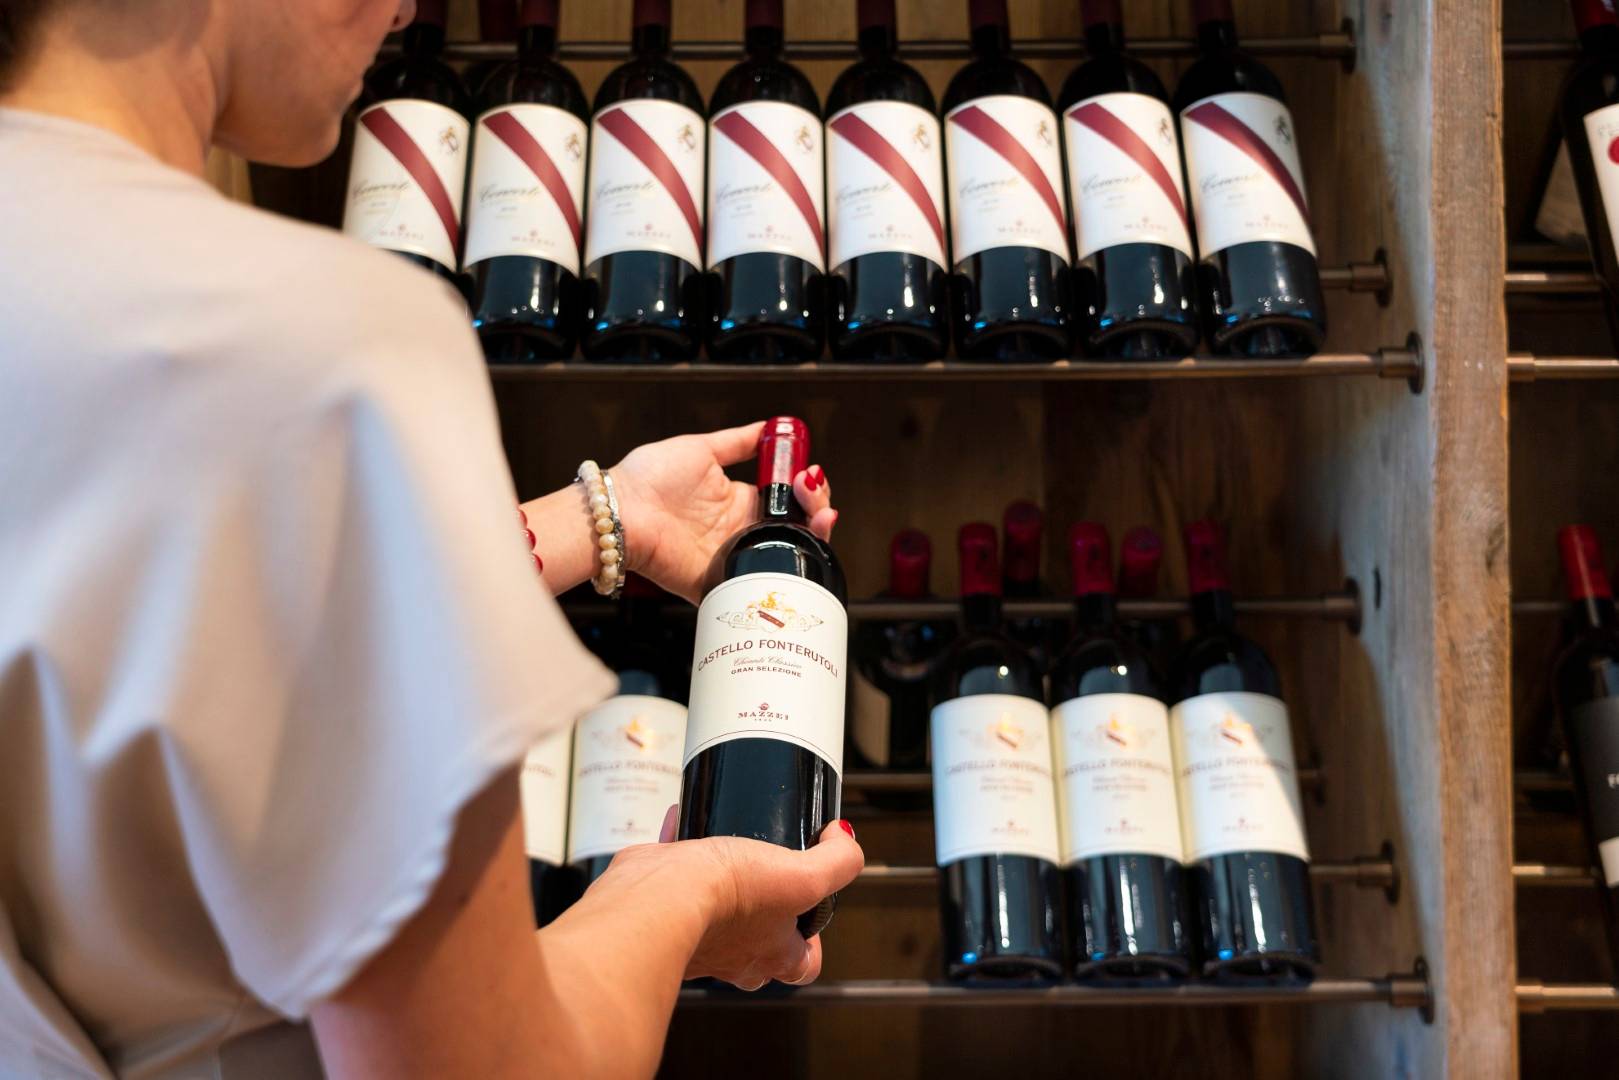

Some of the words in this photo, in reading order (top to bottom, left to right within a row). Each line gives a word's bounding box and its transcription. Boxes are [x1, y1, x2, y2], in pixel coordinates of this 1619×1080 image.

[698, 640, 753, 672] CASTELLO
[759, 639, 838, 679] FONTERUTOLI
[731, 666, 754, 675] GRAN
[757, 665, 802, 678] SELEZIONE
[738, 711, 790, 721] MAZZEI
